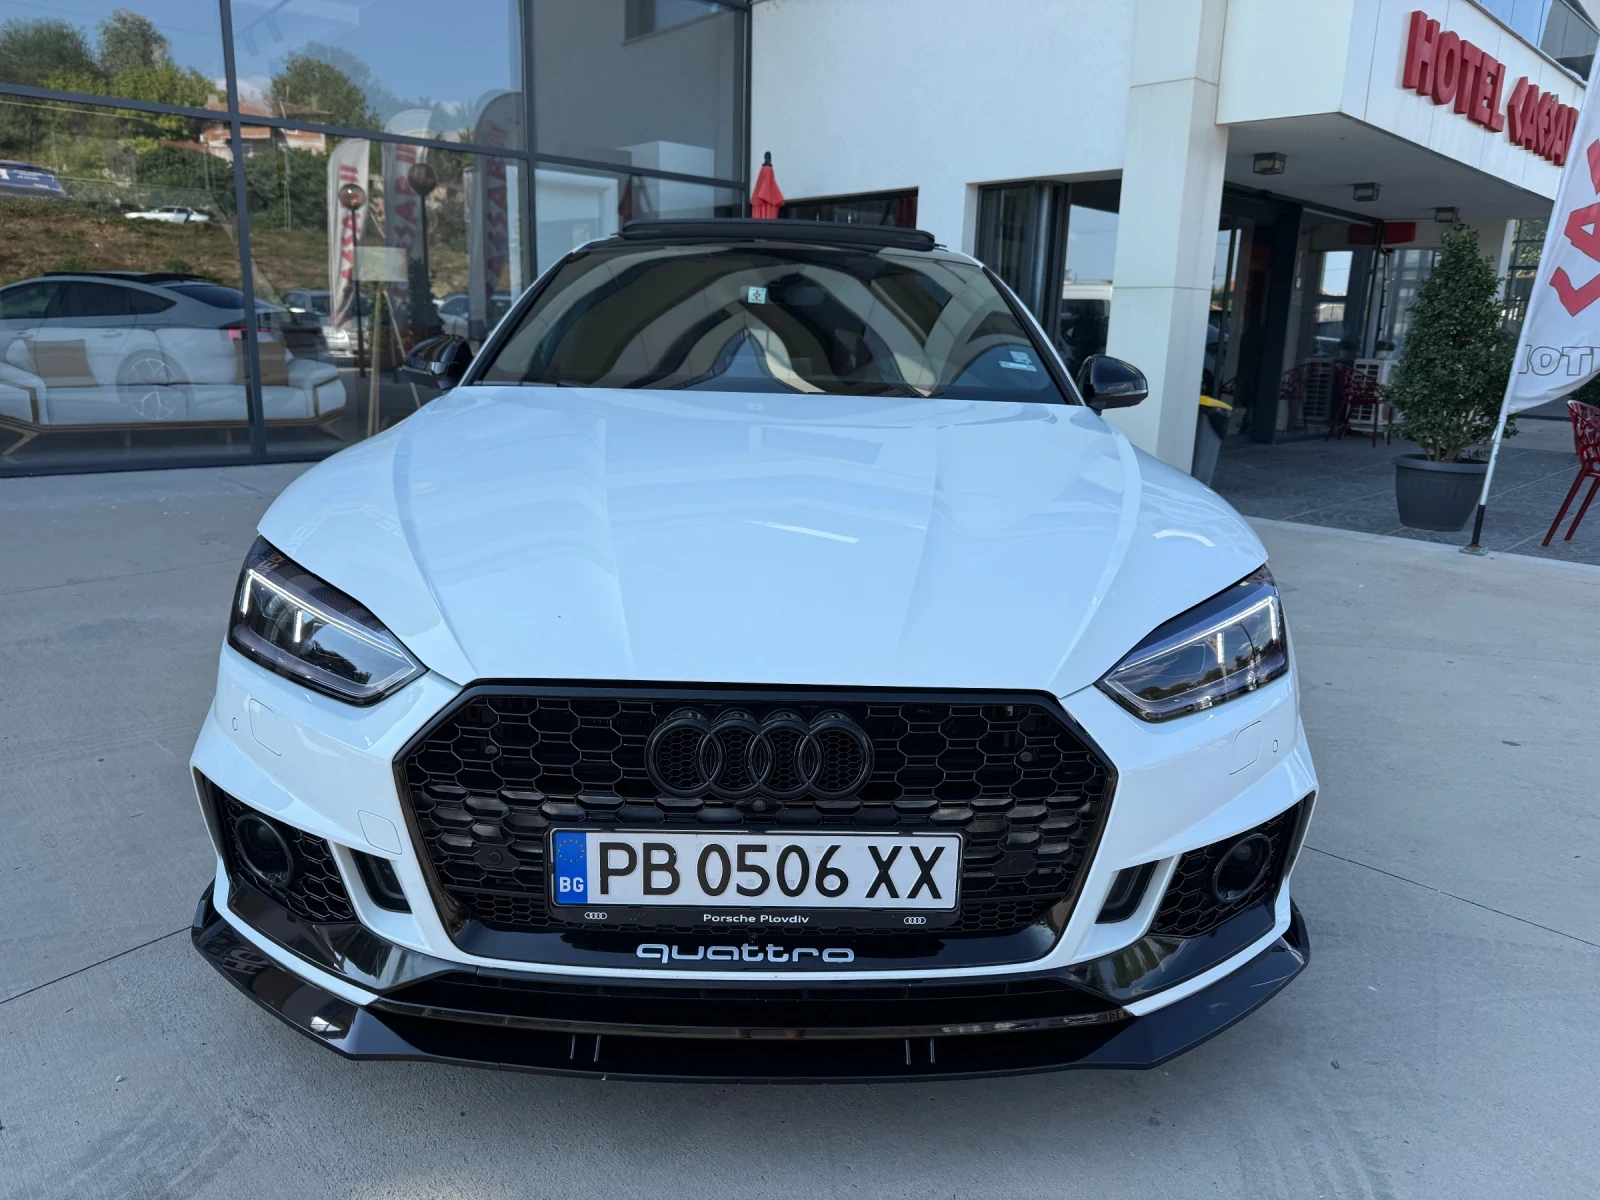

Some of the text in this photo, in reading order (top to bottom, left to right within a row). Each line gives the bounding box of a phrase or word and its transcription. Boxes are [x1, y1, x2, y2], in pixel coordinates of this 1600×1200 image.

[1403, 10, 1506, 133] HOTEL
[599, 842, 947, 899] PB 0506 XX
[559, 877, 584, 893] BG
[703, 914, 809, 924] Porsche Plovdiv
[636, 943, 855, 964] quattro
